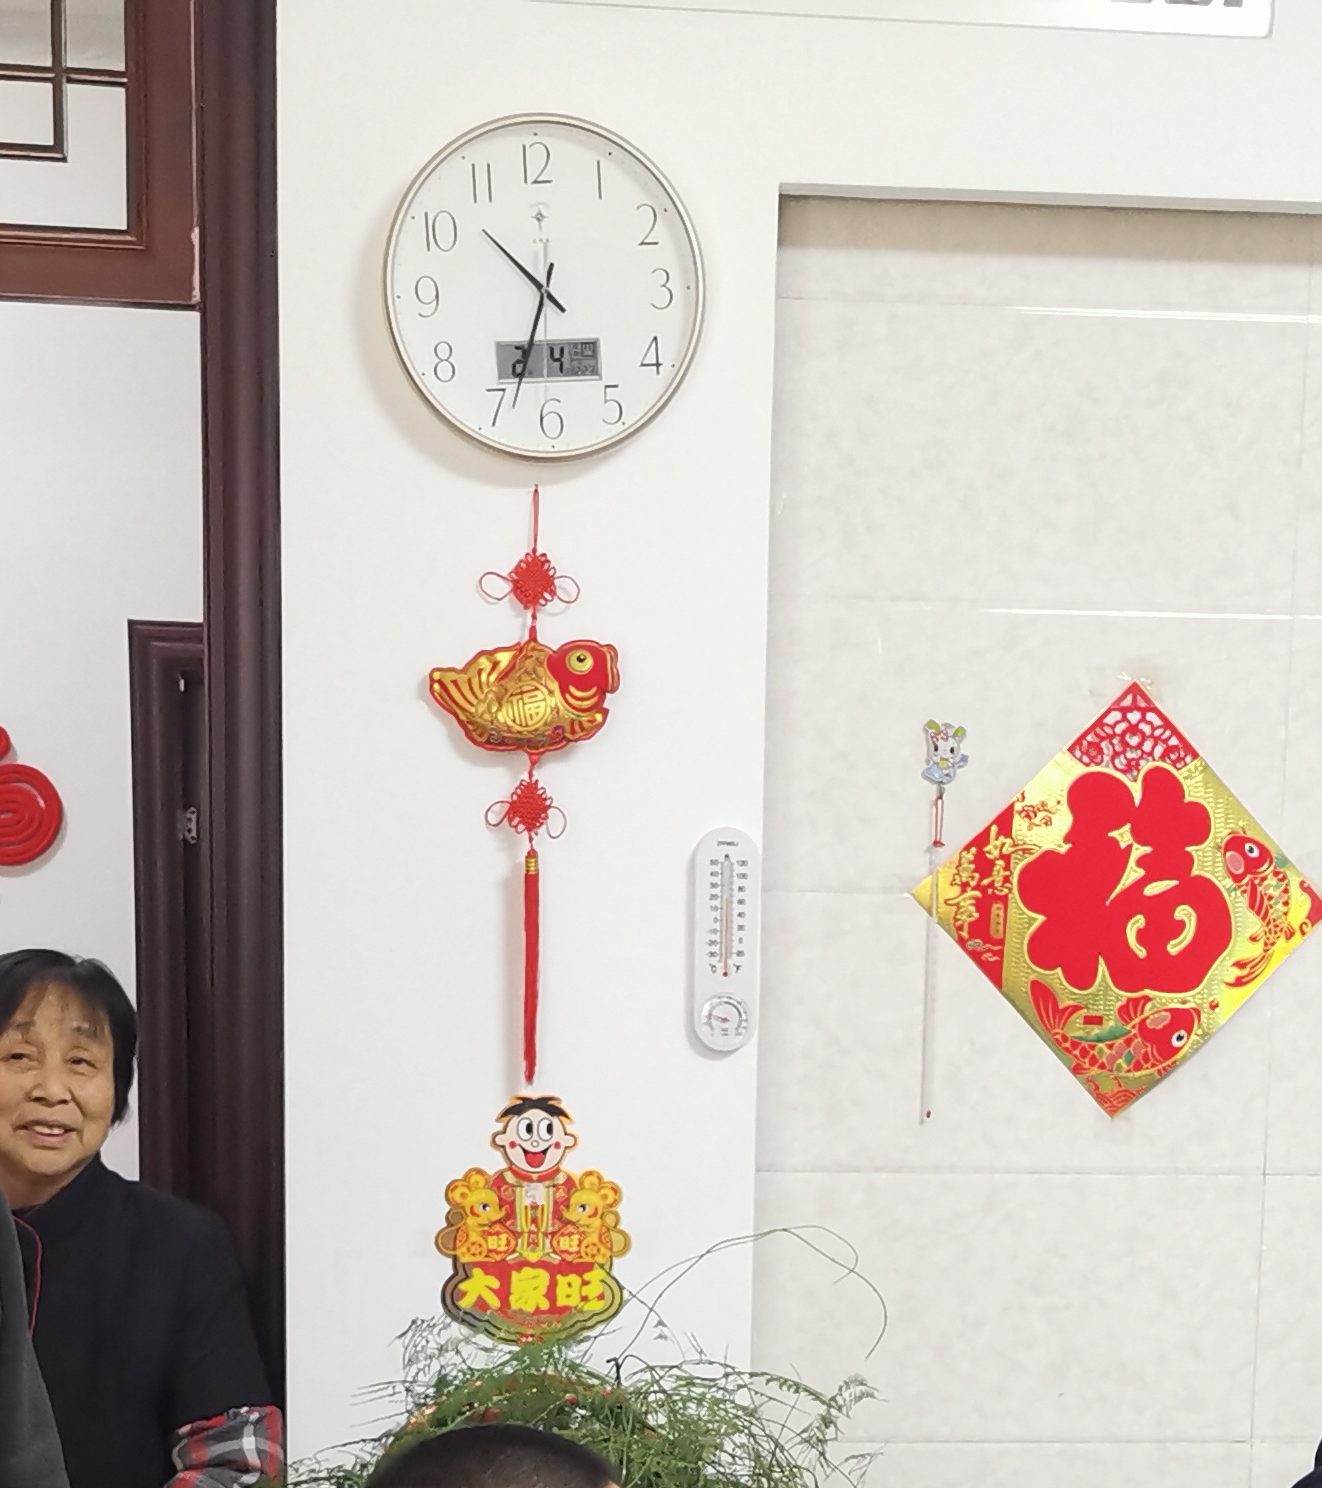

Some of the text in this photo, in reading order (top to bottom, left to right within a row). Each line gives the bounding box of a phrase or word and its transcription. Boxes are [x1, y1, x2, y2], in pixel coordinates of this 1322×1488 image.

[471, 162, 492, 203] 11
[522, 142, 553, 185] 12
[597, 160, 603, 200] 1
[424, 210, 458, 252] 10
[636, 203, 659, 246] 2
[414, 275, 440, 318] 9
[650, 268, 673, 310] 3
[433, 341, 456, 382] 8
[549, 345, 565, 375] 4
[639, 335, 663, 375] 4
[485, 387, 507, 427] 7
[539, 398, 564, 440] 6
[601, 384, 623, 425] 5
[506, 685, 549, 728] 福
[487, 1235, 508, 1251] 旺
[559, 1234, 580, 1251] 旺
[458, 1267, 608, 1312] 大家旺
